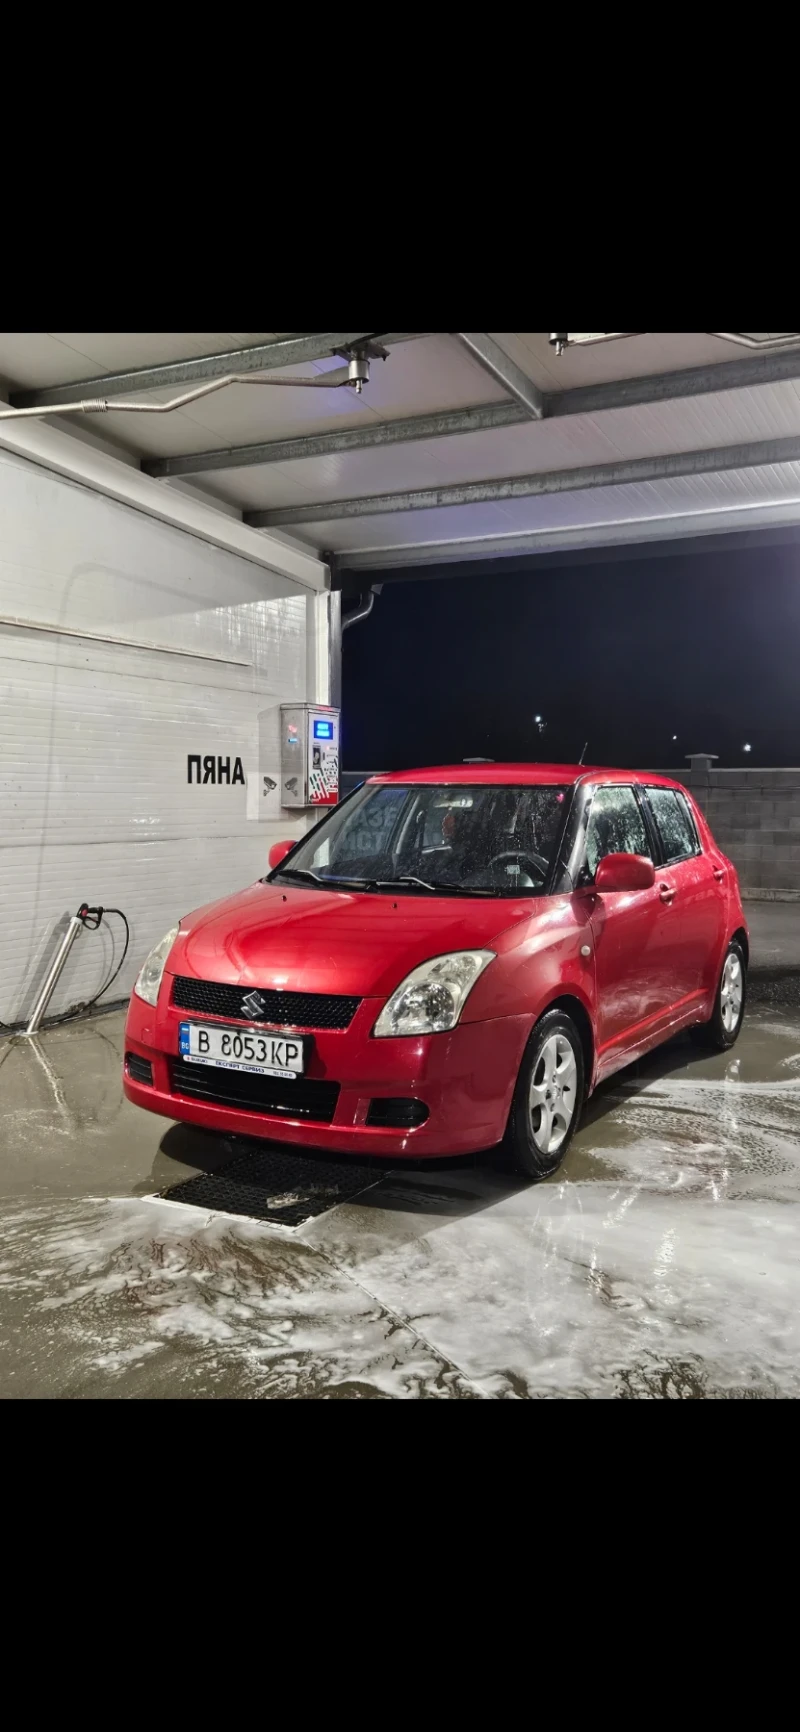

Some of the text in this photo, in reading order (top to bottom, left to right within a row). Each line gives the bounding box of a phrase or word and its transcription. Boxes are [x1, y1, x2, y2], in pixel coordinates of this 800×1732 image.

[187, 755, 245, 785] ПЯНА
[181, 1041, 190, 1050] BG
[198, 1031, 210, 1053] B
